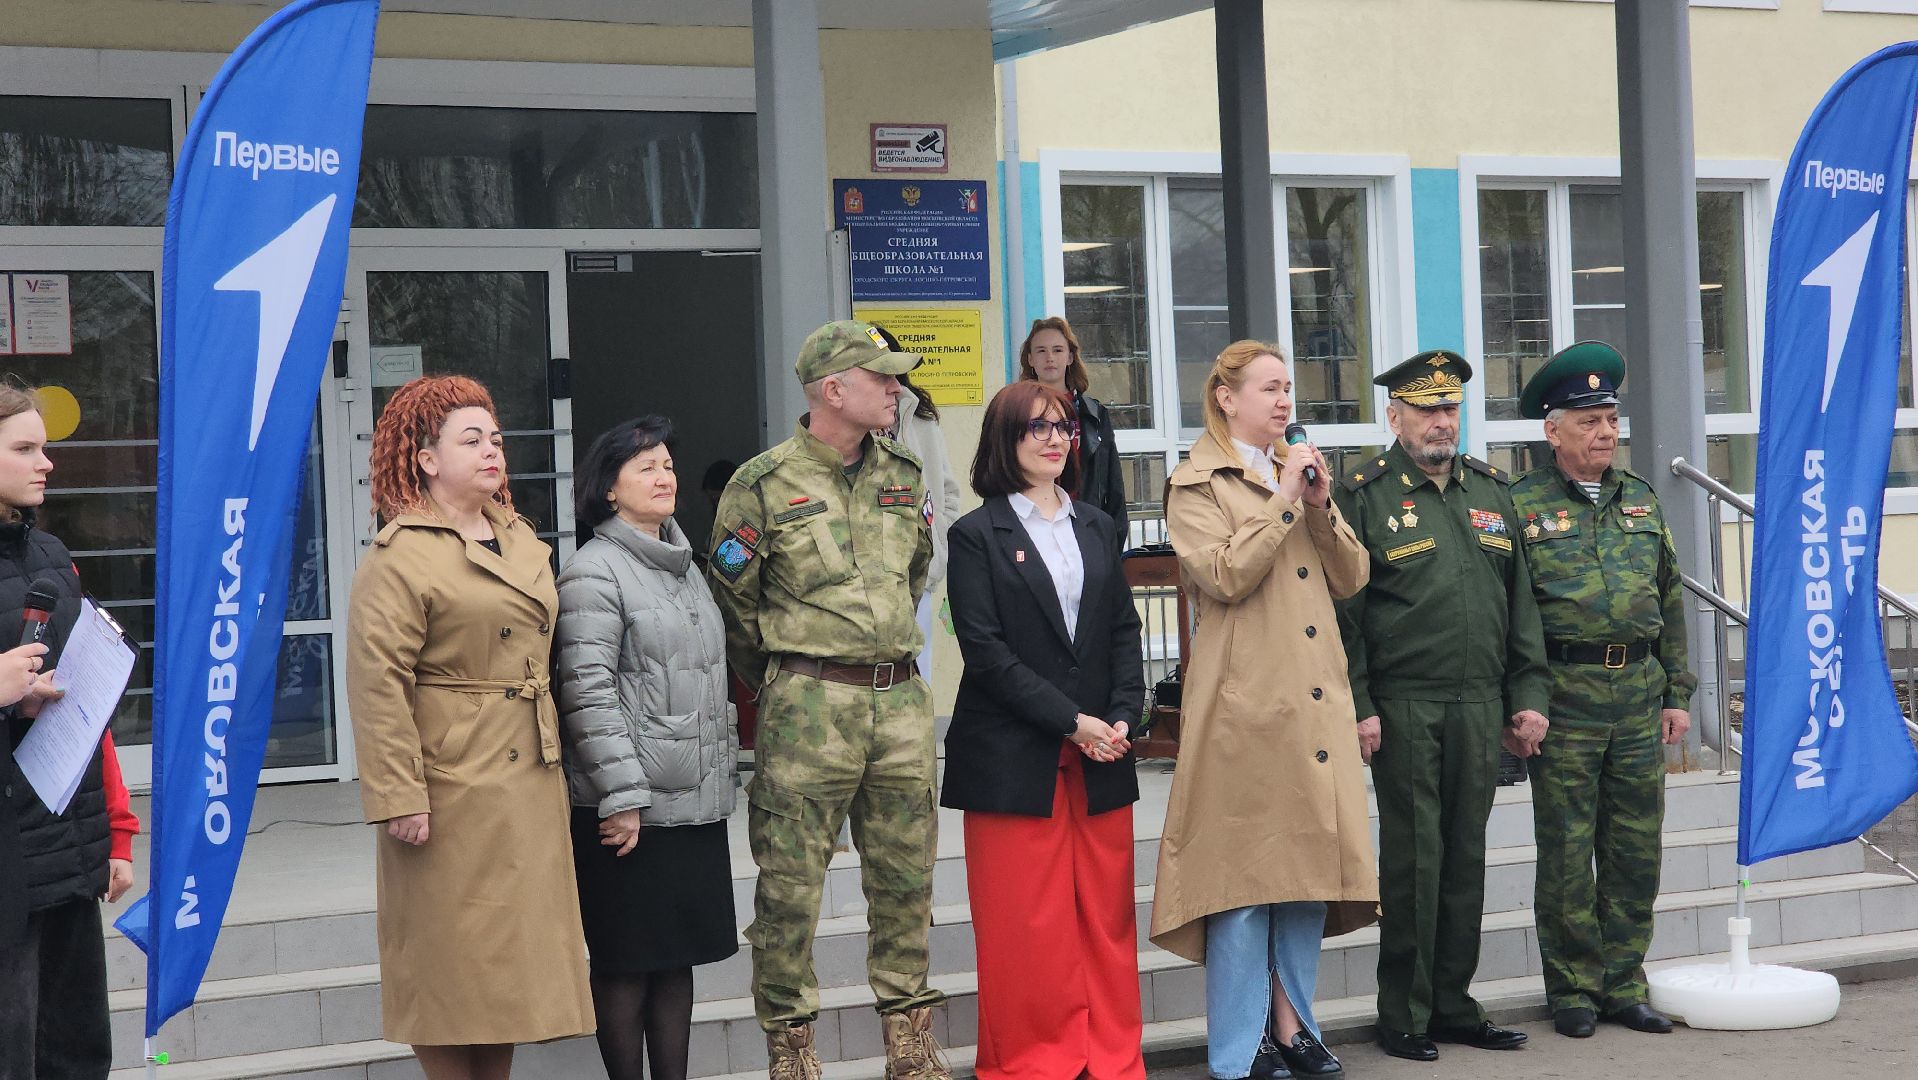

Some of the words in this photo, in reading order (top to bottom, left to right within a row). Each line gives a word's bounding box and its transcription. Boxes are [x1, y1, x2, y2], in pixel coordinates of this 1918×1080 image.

[213, 131, 340, 180] Первые
[1804, 160, 1885, 199] Первые
[888, 237, 938, 247] СРЕДНЯЯ
[852, 251, 983, 261] БЩЕОБРАЗОВАТЕЛЬНАЯ
[884, 265, 926, 274] ШКОЛА
[928, 265, 944, 274] №1
[898, 334, 936, 343] СРЕДНЯЯ
[899, 346, 971, 354] РАЗОВАТЕЛЬНАЯ
